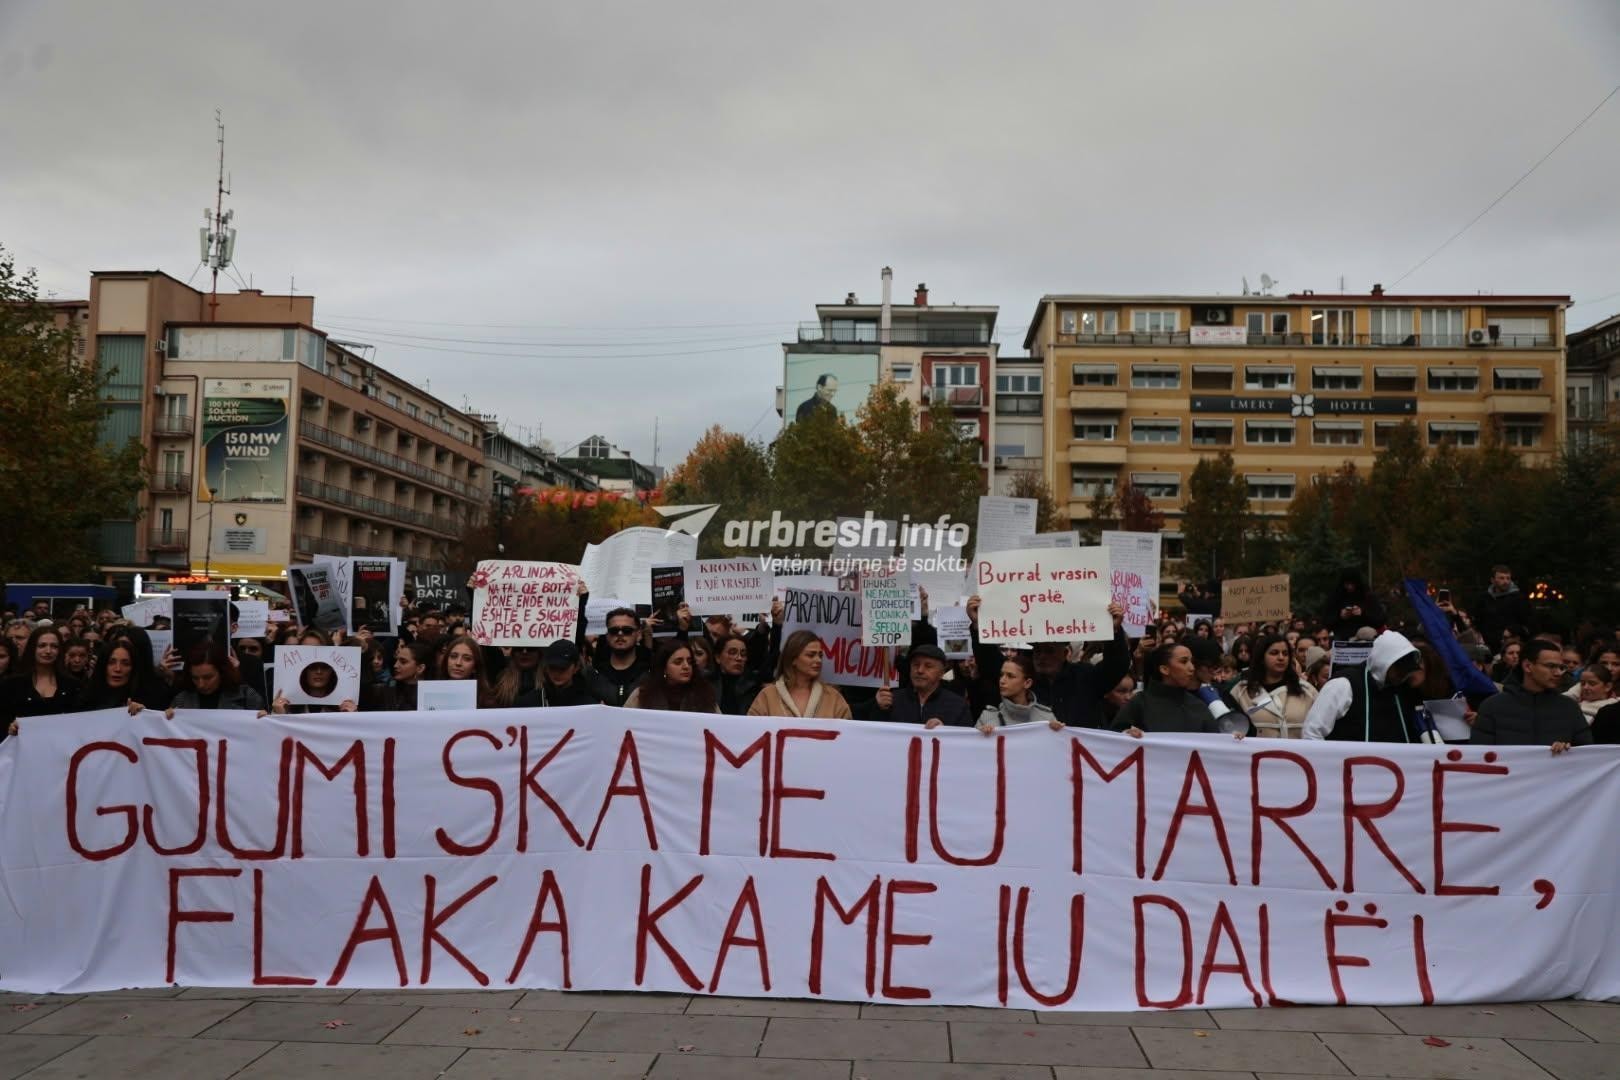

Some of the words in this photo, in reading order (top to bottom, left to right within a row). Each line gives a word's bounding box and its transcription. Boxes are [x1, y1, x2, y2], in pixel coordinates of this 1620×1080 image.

[1230, 399, 1275, 409] EMERY
[1330, 400, 1375, 410] HOTEL
[225, 432, 247, 444] 150
[249, 433, 281, 445] MW
[226, 446, 269, 457] WIND
[502, 565, 557, 579] ARLINDA
[700, 562, 758, 573] KRONIKA
[979, 561, 1041, 585] Burrat
[1050, 567, 1098, 581] vrasin
[415, 574, 446, 588] LIRI
[516, 595, 544, 609] ENDE
[546, 595, 570, 607] NUK
[783, 589, 863, 627] PARANDAL
[523, 609, 531, 622] E
[982, 620, 1033, 639] shteti
[1045, 619, 1096, 636] heshtë
[871, 633, 902, 645] STOP
[67, 737, 395, 861] GJUMI
[700, 729, 840, 861] ME
[905, 735, 1006, 868] IU
[1071, 740, 1555, 909] MARRË,
[165, 868, 571, 988] FLAKA
[635, 864, 771, 993] KA
[808, 875, 937, 999] ME
[998, 885, 1085, 1007] IU
